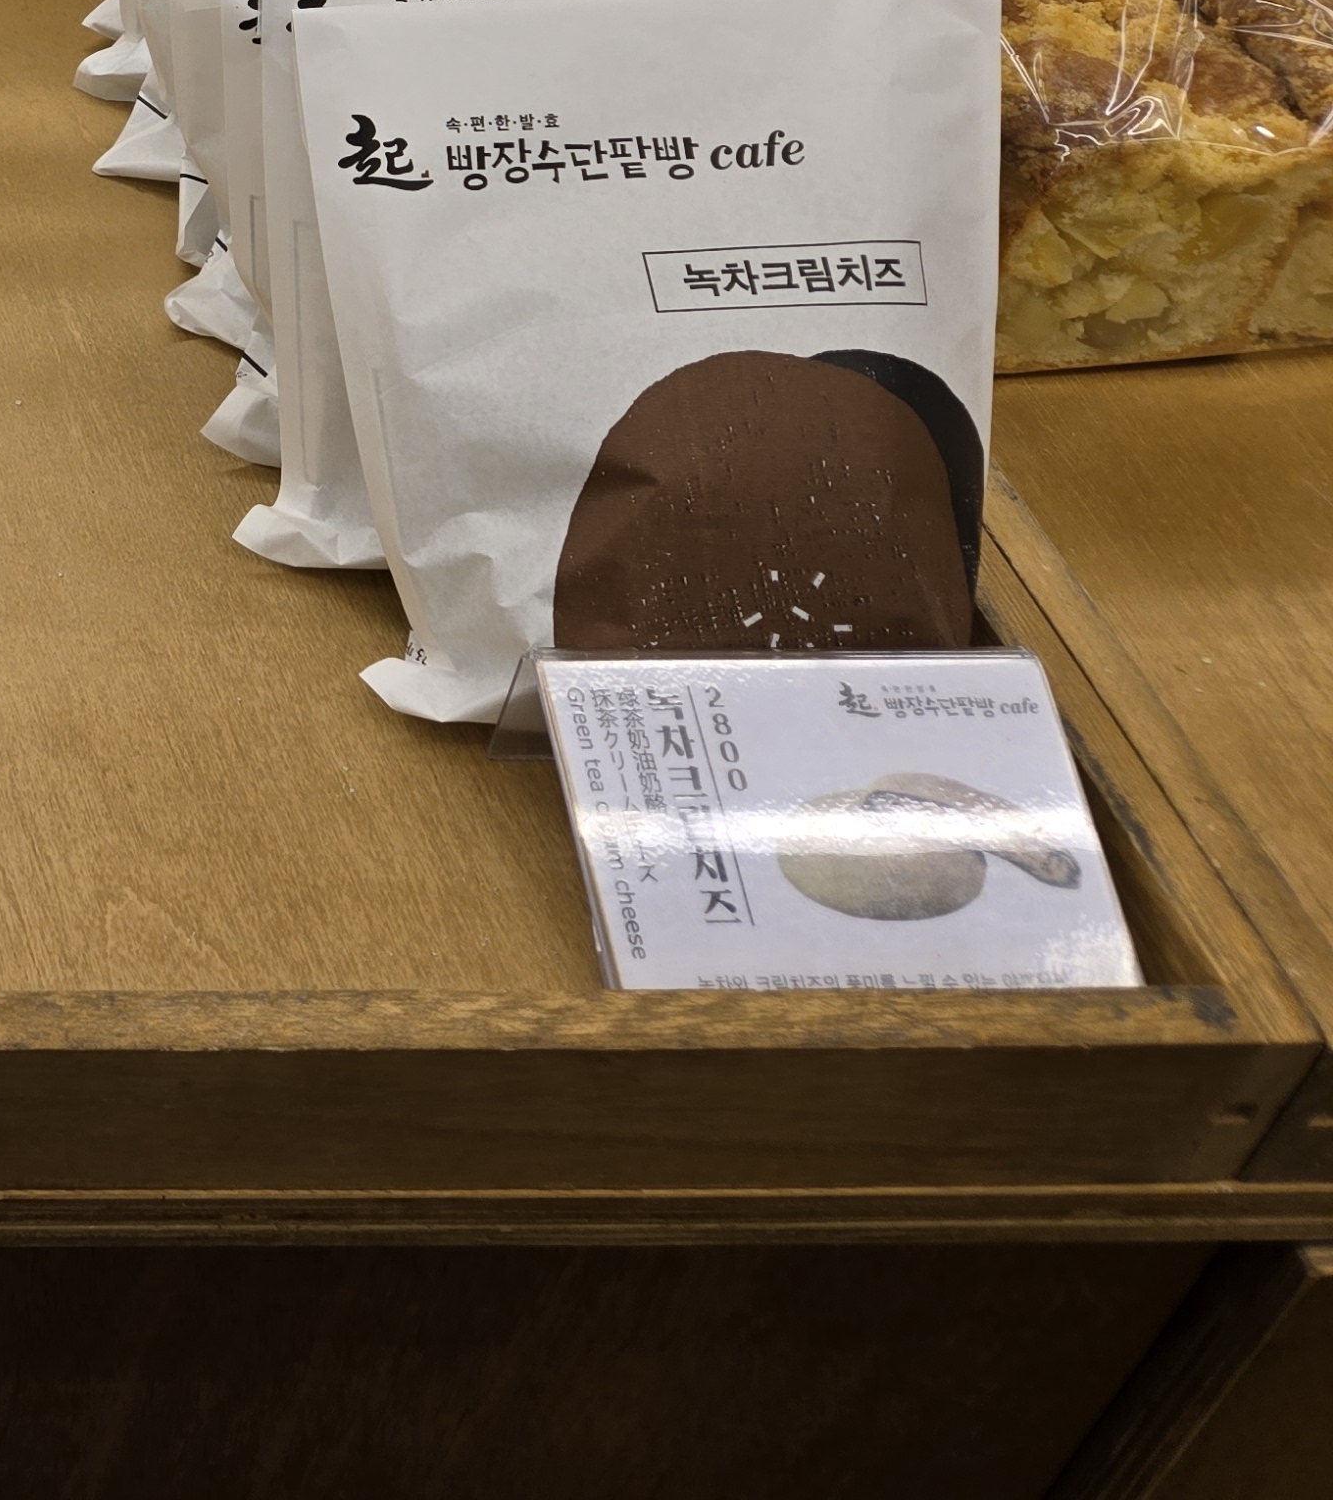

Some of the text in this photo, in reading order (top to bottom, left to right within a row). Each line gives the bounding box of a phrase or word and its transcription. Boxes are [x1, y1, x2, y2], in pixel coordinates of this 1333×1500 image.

[447, 131, 806, 190] 빵장수단팥빵 cafe
[682, 254, 905, 297] 녹차크림치즈
[884, 697, 1039, 718] 빵장수단팥빵 cafe
[703, 687, 748, 792] 2800
[566, 687, 594, 749] Green
[584, 755, 604, 793] tea
[614, 879, 646, 960] cheese
